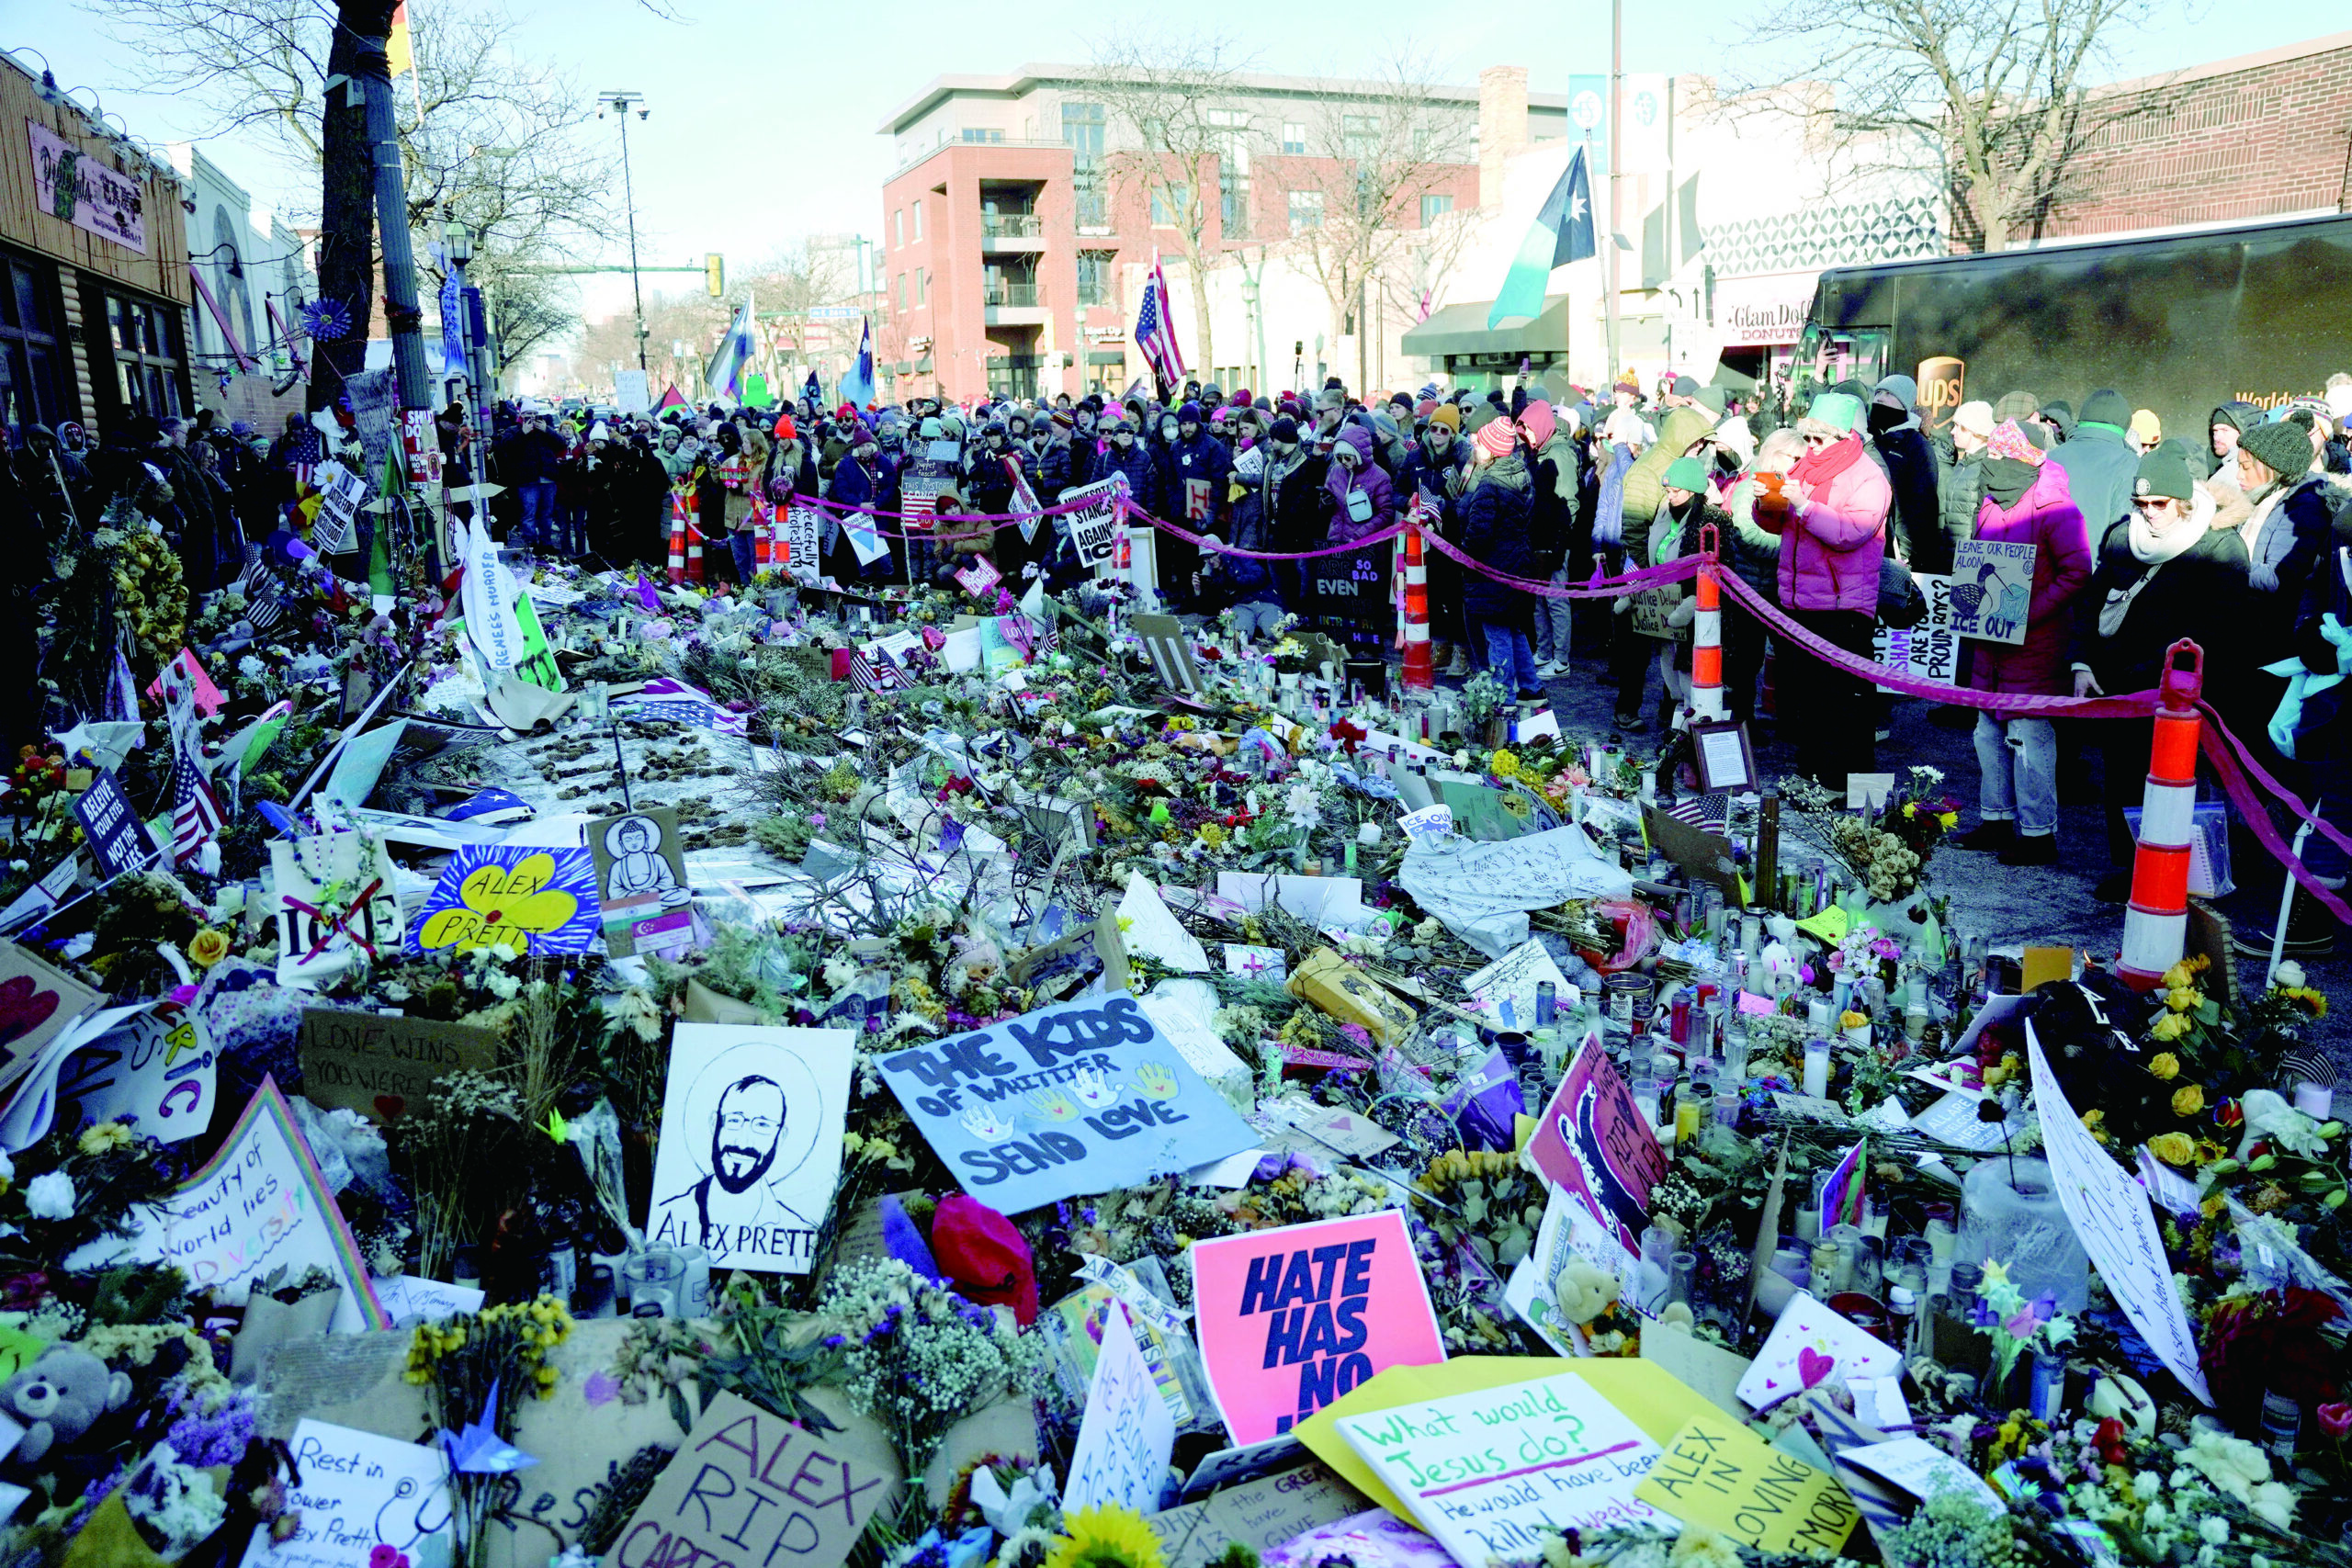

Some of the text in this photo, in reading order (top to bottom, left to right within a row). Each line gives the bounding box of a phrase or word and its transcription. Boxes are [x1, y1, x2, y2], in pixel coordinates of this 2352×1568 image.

[1735, 304, 1775, 327] Glam
[1919, 378, 1961, 418] ups
[341, 497, 356, 517] FOR
[1064, 484, 1110, 504] MINNESOT
[322, 504, 347, 530] RENEE
[787, 507, 802, 569] Protesting
[1082, 542, 1114, 564] IC
[1356, 558, 1372, 570] SO
[1958, 540, 2036, 560] LEAVE OUR PEOPLE
[481, 550, 501, 607] MURDER
[1317, 579, 1359, 596] EVEN
[1351, 570, 1378, 581] BAD
[1004, 626, 1029, 637] LOVE
[1949, 611, 2017, 638] ICE OUT
[1909, 637, 1929, 666] ARE
[1928, 628, 1952, 679] PROUD
[82, 777, 116, 824] BELEIVE
[93, 798, 124, 840] YOUR EYES
[1404, 815, 1424, 828] ICE
[107, 822, 138, 867] NOT THE
[467, 874, 547, 897] ALEX
[310, 1021, 461, 1065] LOVE WINS
[884, 998, 1155, 1089] THE KIDS
[312, 1059, 420, 1097] YOU WERE
[915, 1053, 1121, 1118] OF WHITTIER
[1928, 1097, 1972, 1130] ALL ARE
[1955, 1120, 1991, 1145] HERE
[245, 1131, 264, 1172] of
[959, 1131, 1088, 1186] SEND
[1083, 1098, 1190, 1141] LOVE
[1605, 1115, 1634, 1176] RIP
[1632, 1139, 1668, 1194] ALEX
[158, 1214, 232, 1260] World
[242, 1173, 278, 1218] lies
[192, 1182, 308, 1283] Diversity
[656, 1209, 729, 1251] ALEX
[1081, 1258, 1130, 1294] ALEX
[1238, 1237, 1377, 1316] HATE
[1548, 1253, 1561, 1281] ALEX
[380, 1284, 458, 1309] In Memory
[1262, 1296, 1370, 1370] HAS
[1097, 1358, 1120, 1413] HE
[1122, 1351, 1150, 1421] NOW
[1297, 1352, 1374, 1412] NO
[1164, 1391, 1192, 1422] IN
[1351, 1383, 1569, 1450] What would
[296, 1436, 385, 1480] Rest in
[695, 1414, 883, 1527] ALEX
[1104, 1428, 1117, 1472] TO
[1385, 1416, 1590, 1493] Jesus do?
[1652, 1424, 1729, 1501] ALEX
[1433, 1450, 1663, 1522] He would have been
[1702, 1458, 1744, 1495] IN
[288, 1489, 343, 1511] ower
[675, 1462, 820, 1568] RIP
[1228, 1488, 1267, 1511] the
[1241, 1485, 1330, 1529] have for
[1566, 1495, 1657, 1531] weeks
[1787, 1473, 1855, 1555] EMORY
[323, 1517, 375, 1551] Pretti
[1264, 1515, 1317, 1550] GIVE
